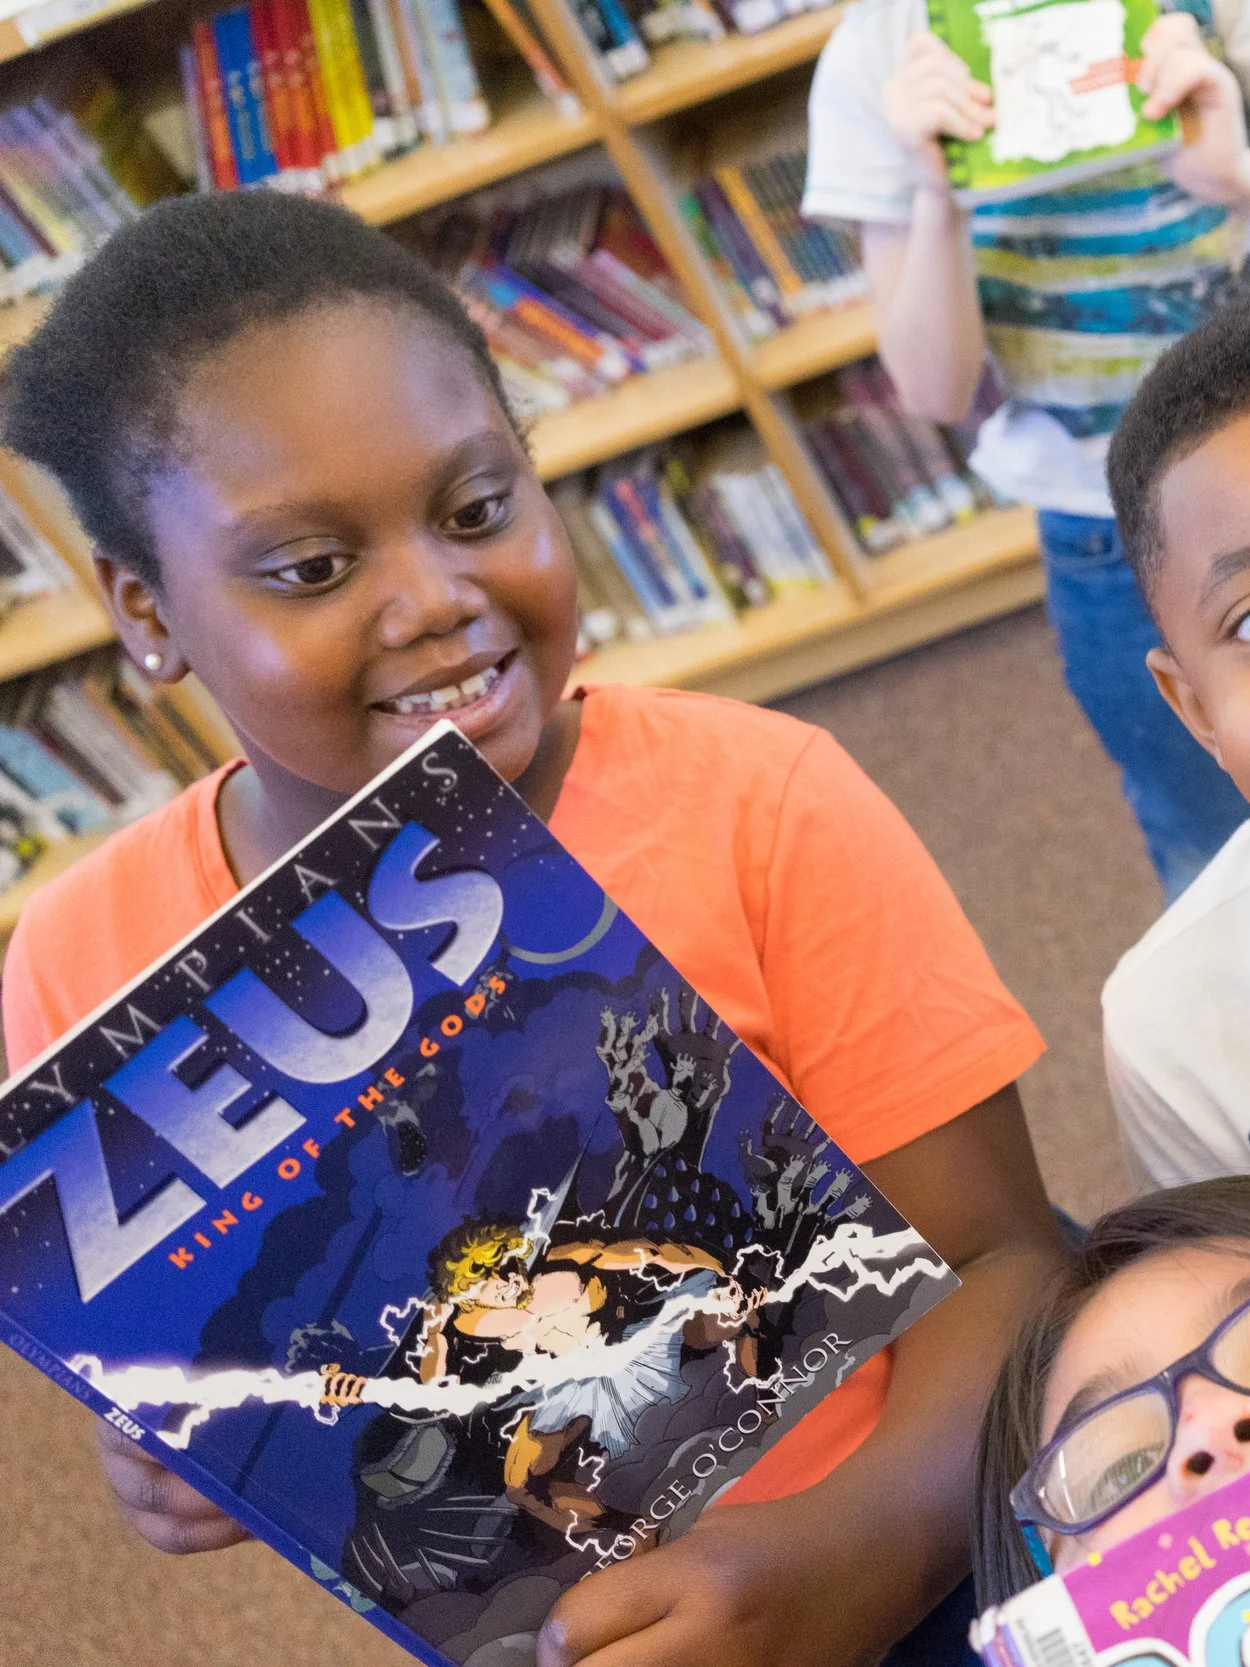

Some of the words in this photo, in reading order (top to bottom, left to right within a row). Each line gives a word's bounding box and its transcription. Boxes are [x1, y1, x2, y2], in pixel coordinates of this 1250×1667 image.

[0, 821, 505, 1301] ZEUS
[168, 1191, 263, 1270] KING
[277, 1137, 321, 1181] OF
[334, 1066, 406, 1130] THE
[419, 974, 507, 1058] GODS
[103, 1406, 146, 1440] ZEUS
[691, 1331, 853, 1479] O'CONNOR
[1109, 1538, 1217, 1630] Rachel
